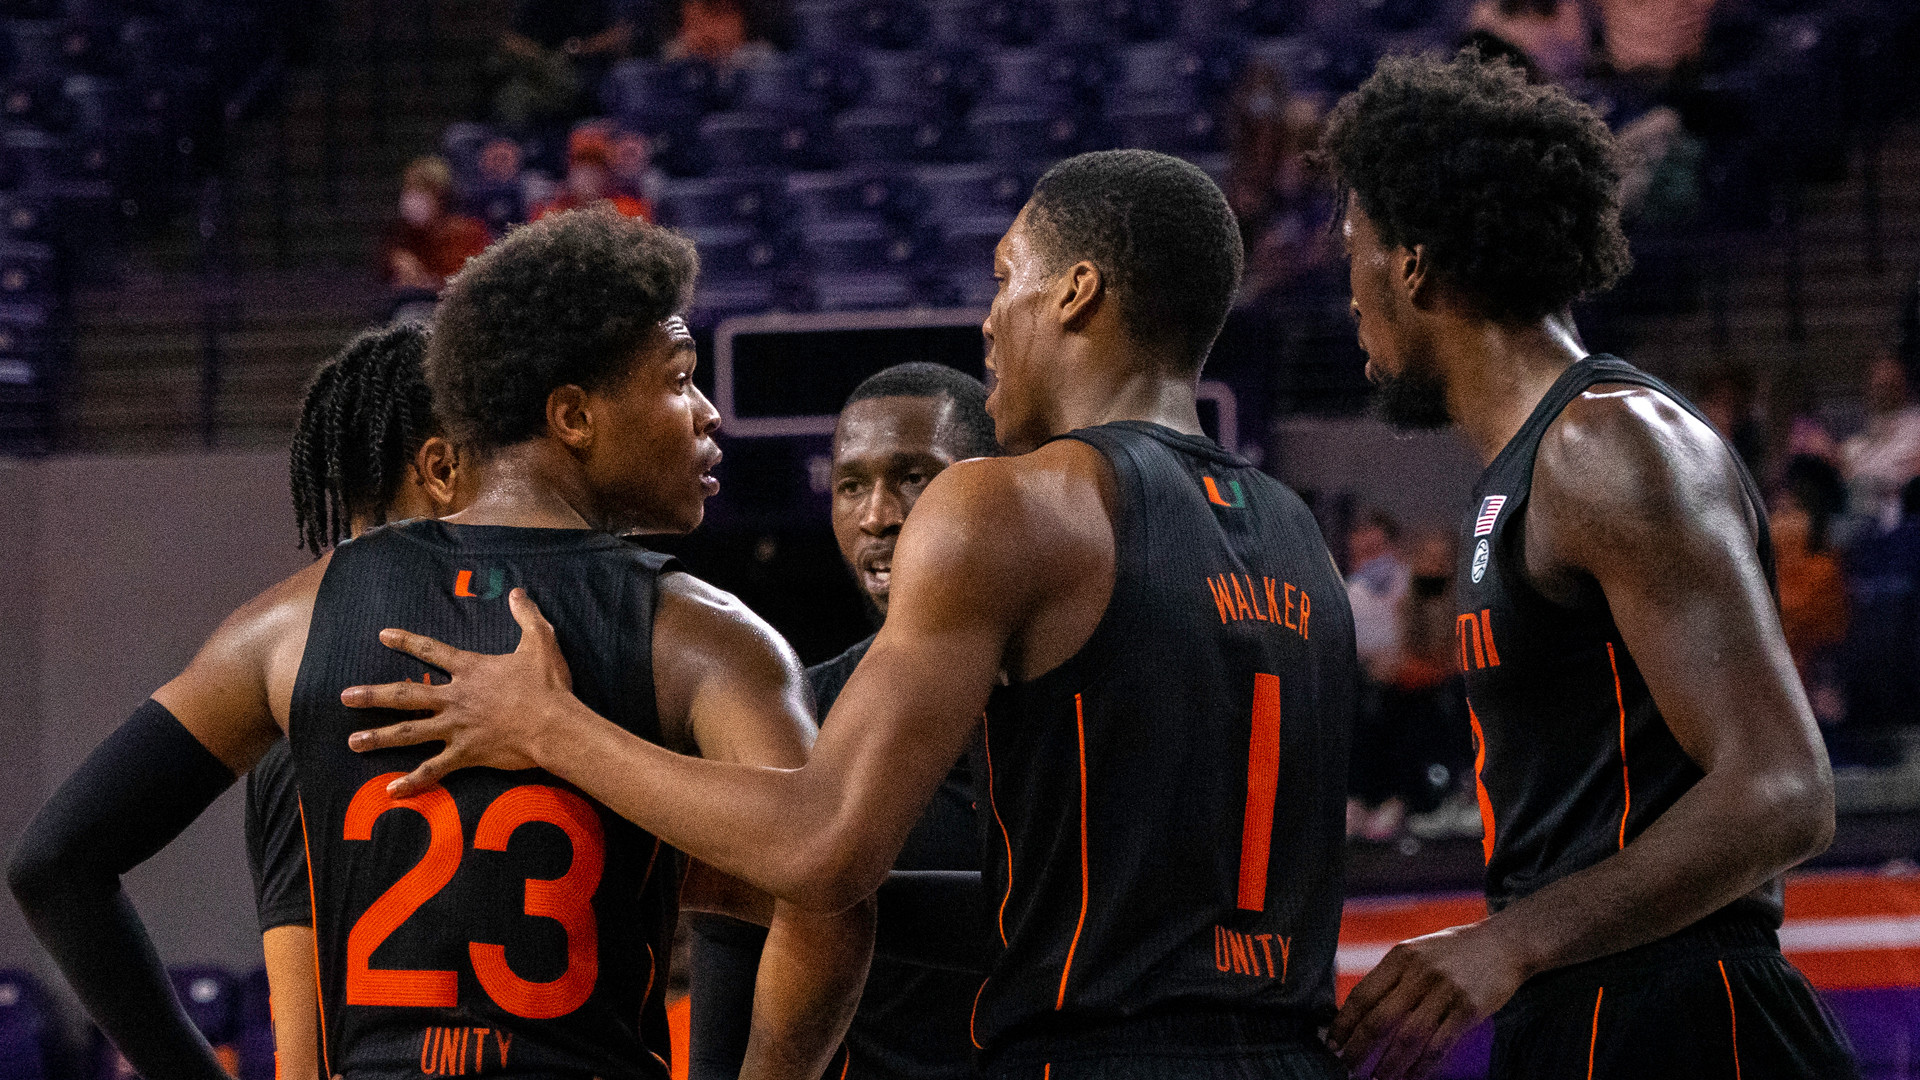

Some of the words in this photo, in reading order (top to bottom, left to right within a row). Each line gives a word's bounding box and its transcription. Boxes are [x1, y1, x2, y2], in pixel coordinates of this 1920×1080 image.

[1207, 573, 1312, 640] WALKER
[1238, 673, 1281, 912] 1
[343, 771, 606, 1020] 23
[1215, 926, 1292, 984] UNITY
[421, 1027, 514, 1076] UNITY
